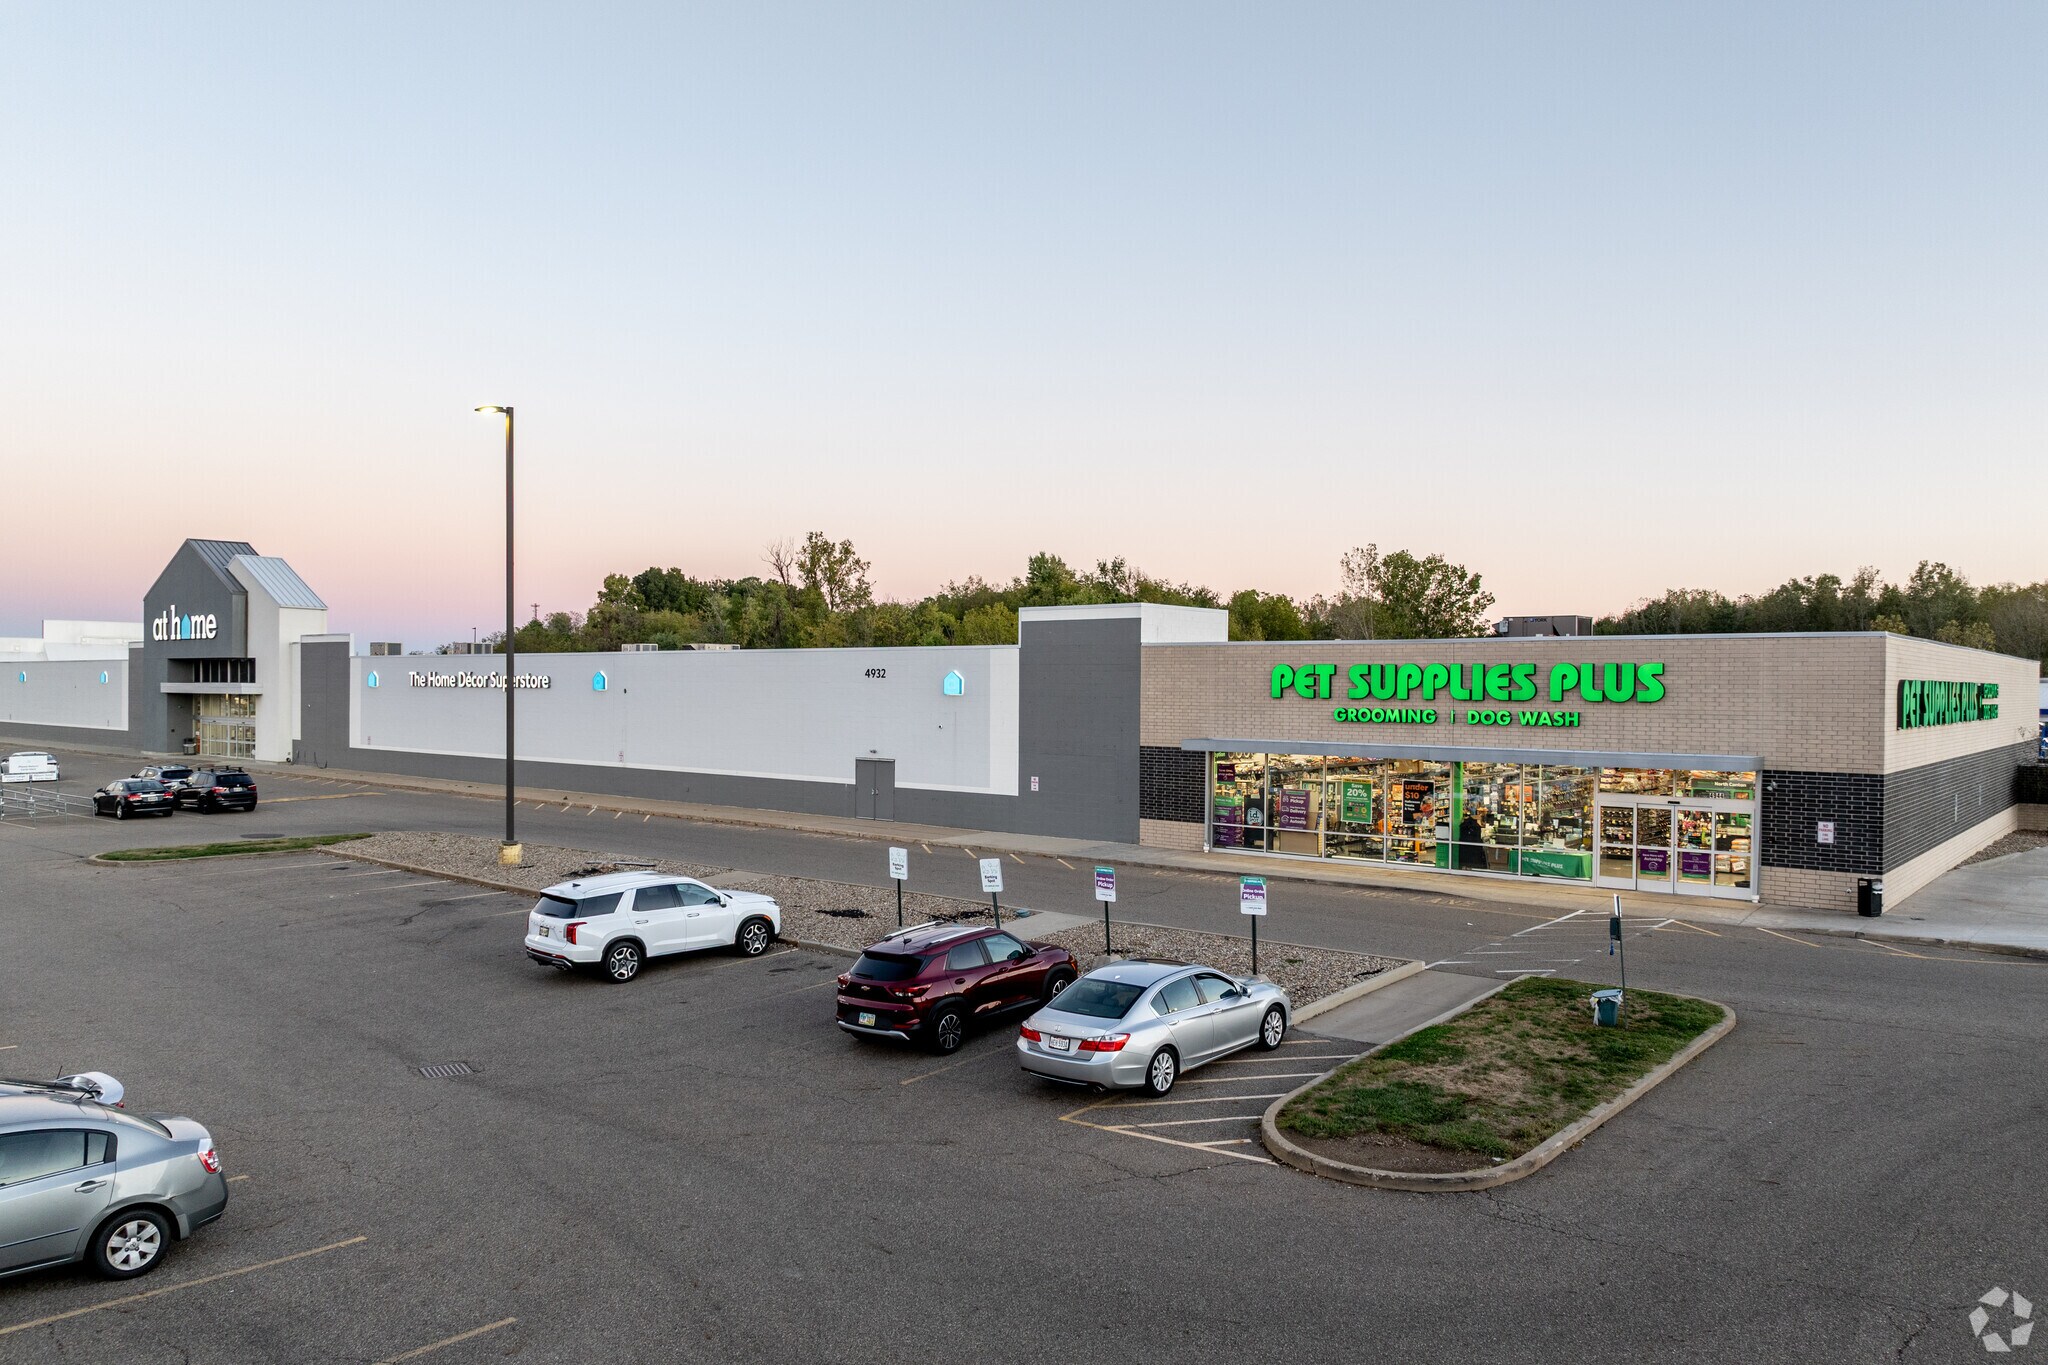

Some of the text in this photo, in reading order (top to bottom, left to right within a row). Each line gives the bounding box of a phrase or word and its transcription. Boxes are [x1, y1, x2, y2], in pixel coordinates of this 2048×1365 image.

[153, 604, 218, 641] at home
[408, 671, 427, 688] The
[428, 671, 457, 688] Home
[458, 671, 489, 688] Décor
[865, 668, 887, 679] 4932
[1271, 662, 1666, 703] PET SUPPLIES PLUS
[1902, 679, 1978, 729] PET SUPPLIES PLUS
[1333, 707, 1580, 727] GROOMING DOG WASH
[1346, 788, 1368, 797] 20%
[1405, 783, 1429, 791] under
[1405, 791, 1420, 800] $10
[1097, 881, 1113, 889] Pickup
